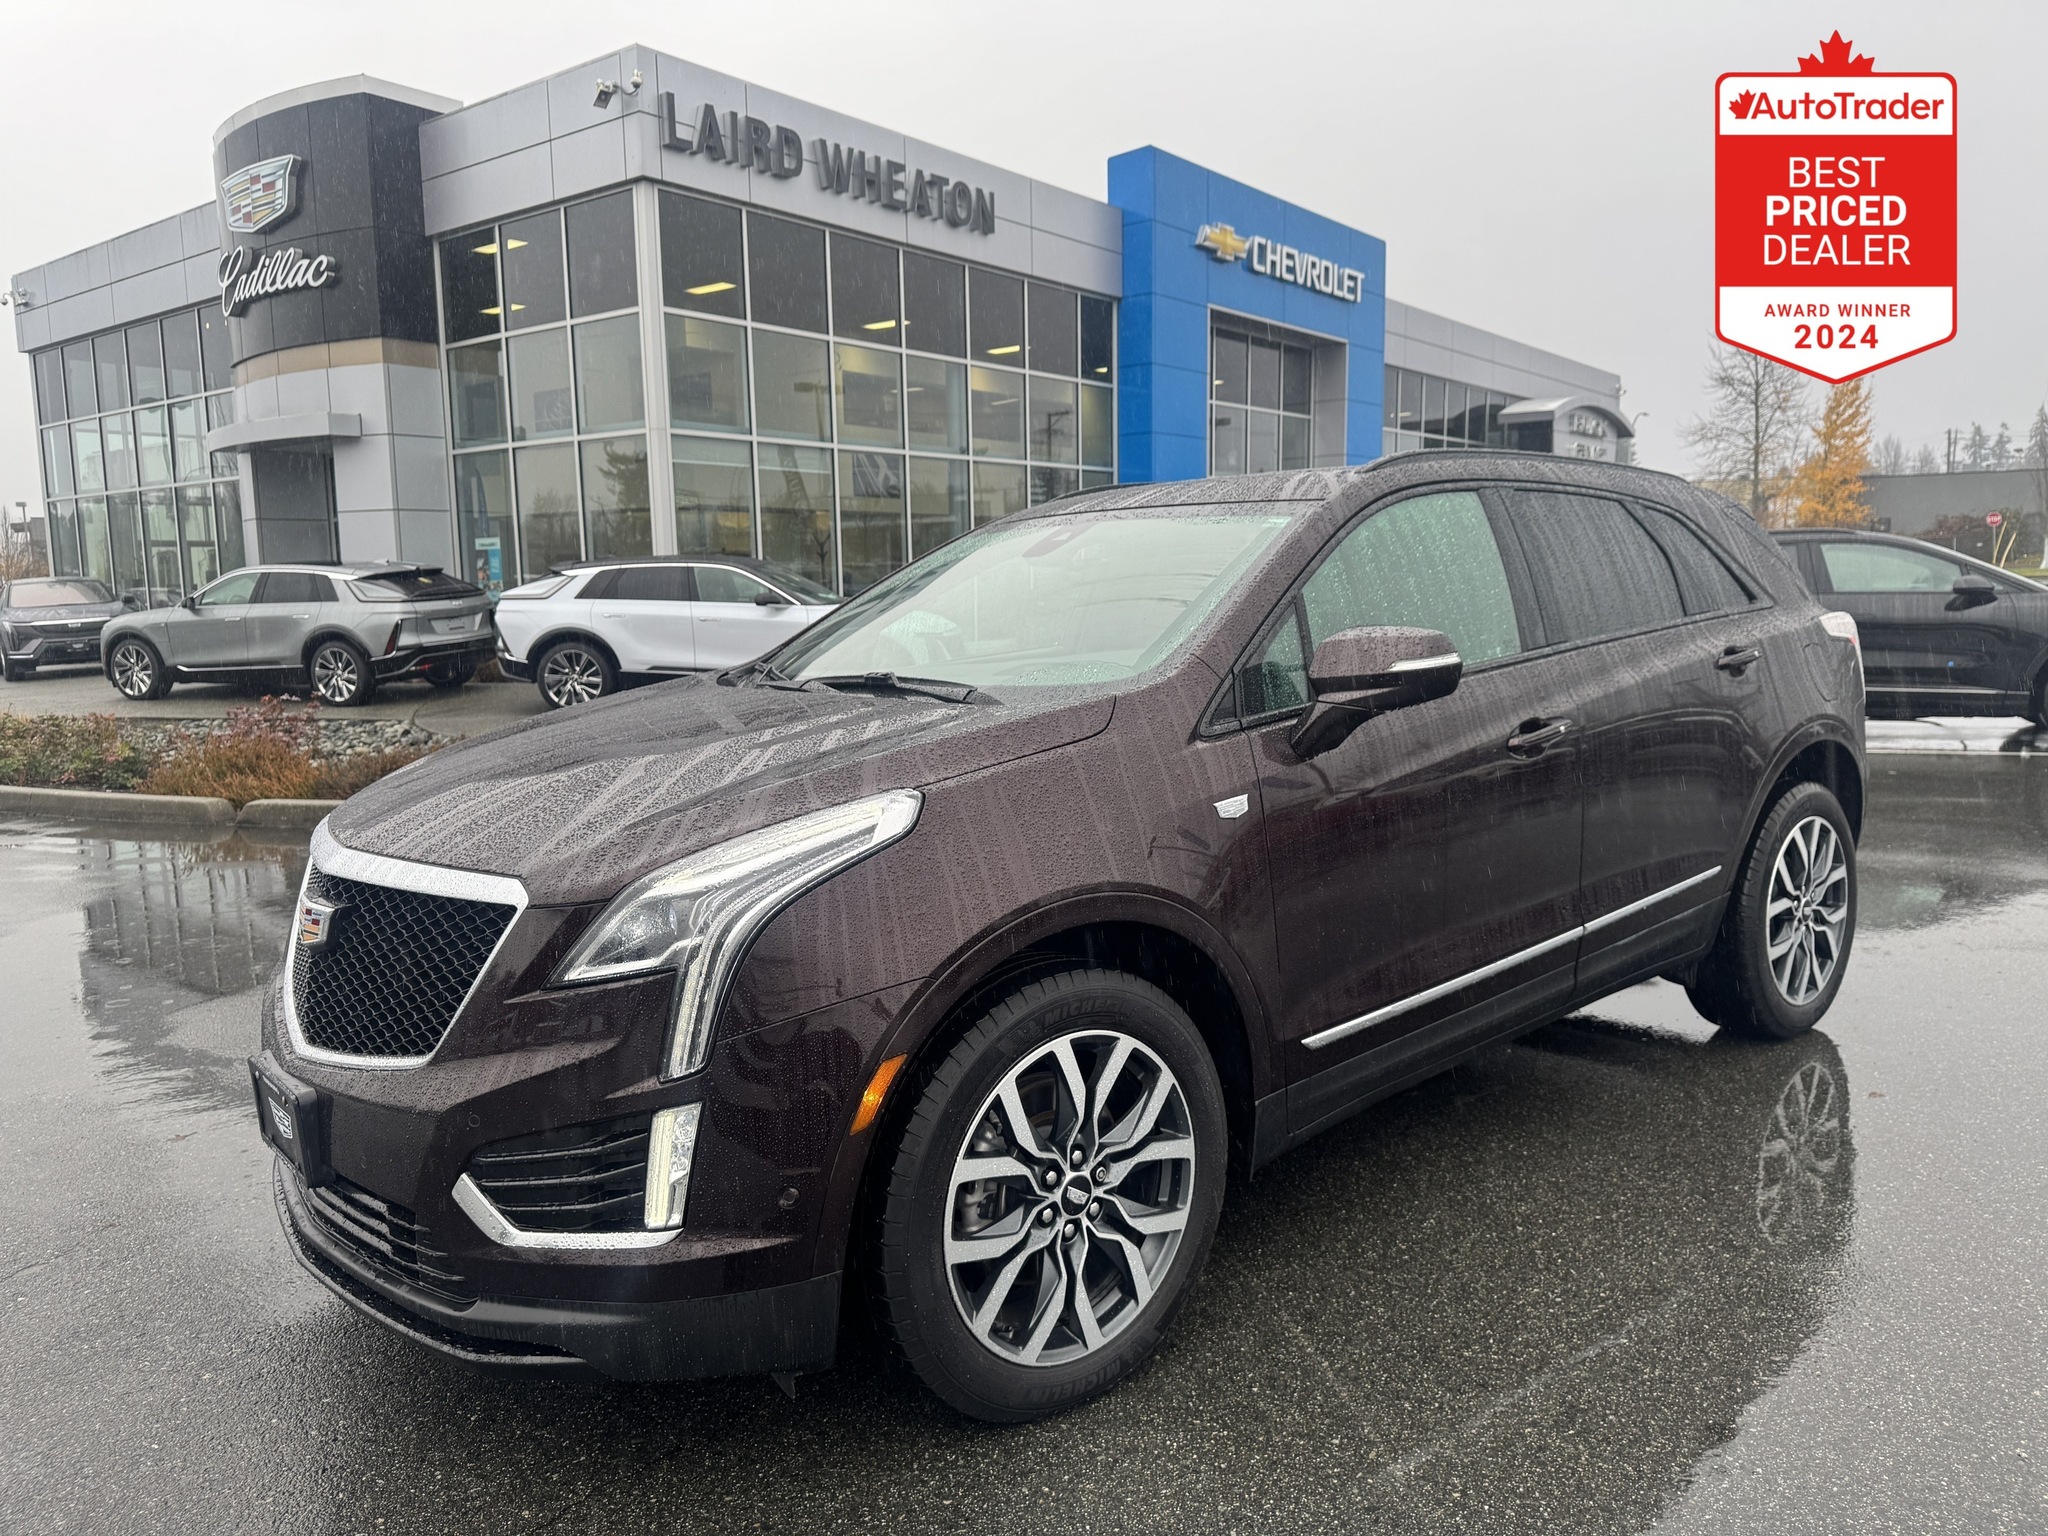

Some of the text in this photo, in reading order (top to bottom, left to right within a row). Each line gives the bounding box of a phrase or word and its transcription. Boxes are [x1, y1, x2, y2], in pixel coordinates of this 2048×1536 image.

[661, 90, 996, 236] LAIRD WHEATON
[217, 245, 331, 318] Cadillac
[1250, 235, 1366, 304] CHEVROLET
